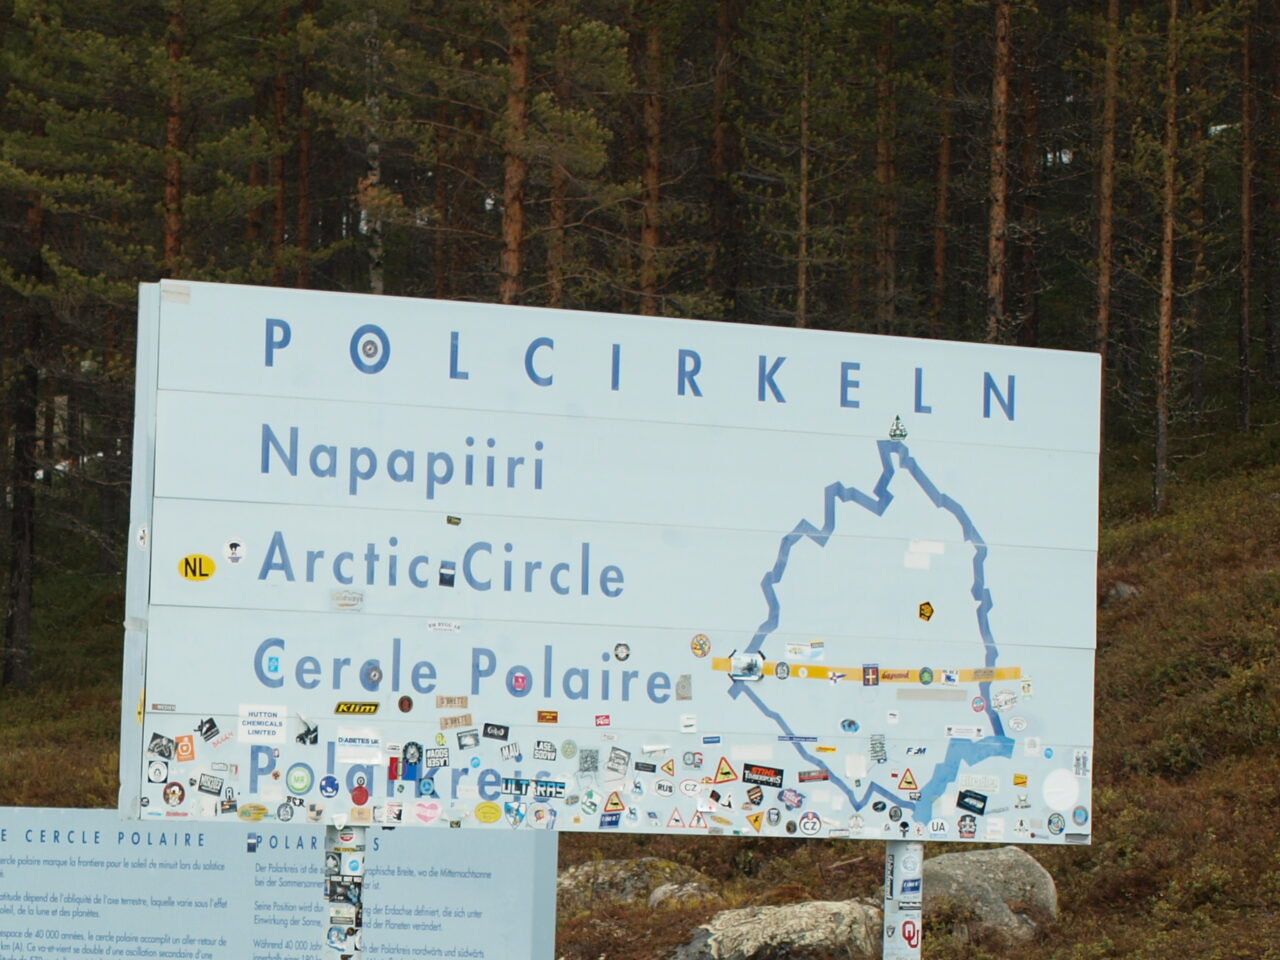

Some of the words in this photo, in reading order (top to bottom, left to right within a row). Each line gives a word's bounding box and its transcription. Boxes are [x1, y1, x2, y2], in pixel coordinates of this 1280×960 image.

[264, 317, 1016, 421] POLCIRKELN
[261, 424, 544, 500] Napapiiri
[184, 558, 210, 578] NL
[258, 531, 430, 590] Arctic
[462, 541, 625, 598] Circle
[253, 637, 437, 695] Cercle
[470, 645, 672, 704] Polaire
[338, 702, 376, 713] Klim
[242, 719, 283, 727] CHEMICALS
[751, 766, 778, 777] STIHL
[658, 783, 673, 793] RUS
[684, 783, 697, 792] CZ
[802, 821, 818, 832] CZ
[931, 822, 946, 832] UA
[25, 829, 101, 844] CERCLE
[118, 831, 206, 847] POLAIRE
[256, 835, 380, 851] POLARS
